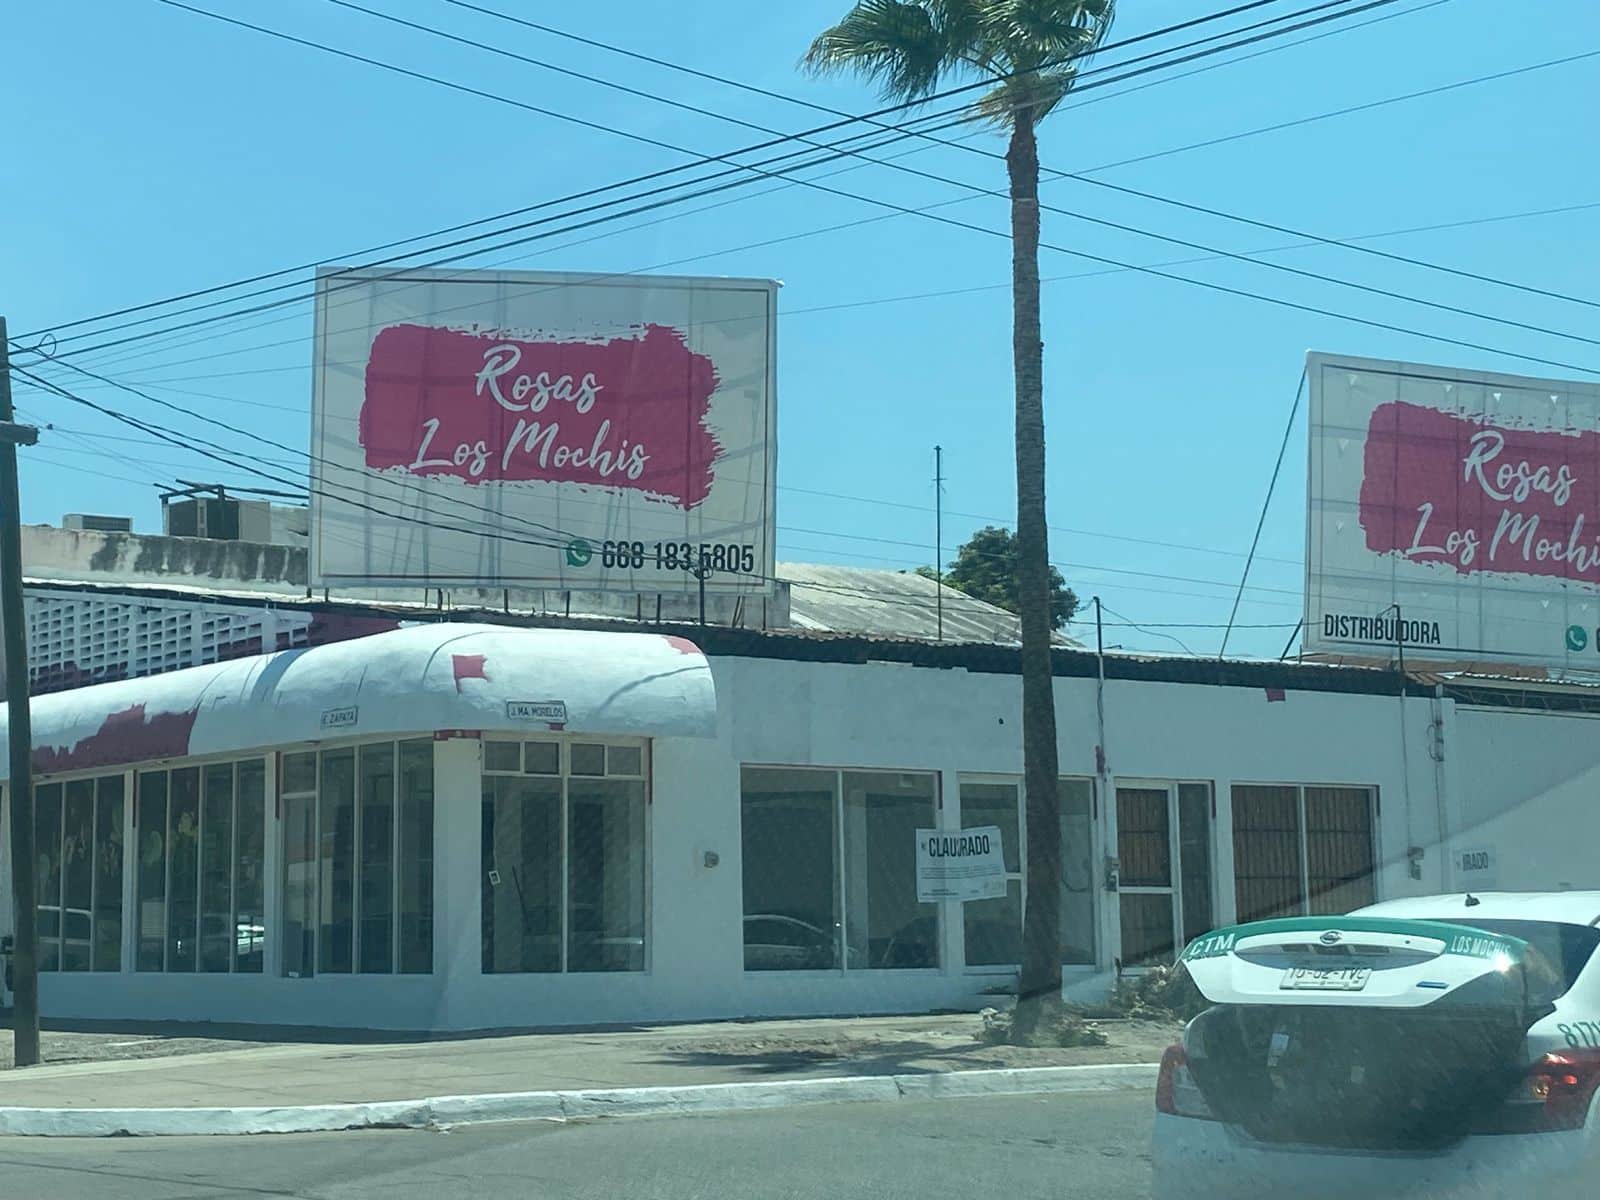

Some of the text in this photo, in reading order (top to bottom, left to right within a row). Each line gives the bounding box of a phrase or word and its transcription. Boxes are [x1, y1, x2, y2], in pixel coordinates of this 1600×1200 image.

[475, 344, 604, 413] Rosas
[409, 417, 651, 479] Los Mochis
[1463, 430, 1577, 506] Rosas
[602, 540, 754, 572] 668 183 5805
[1405, 502, 1480, 566] Los
[1324, 613, 1441, 645] DISTRIBUIDORA
[330, 711, 354, 724] ZAPATA
[1451, 935, 1472, 953] LOS
